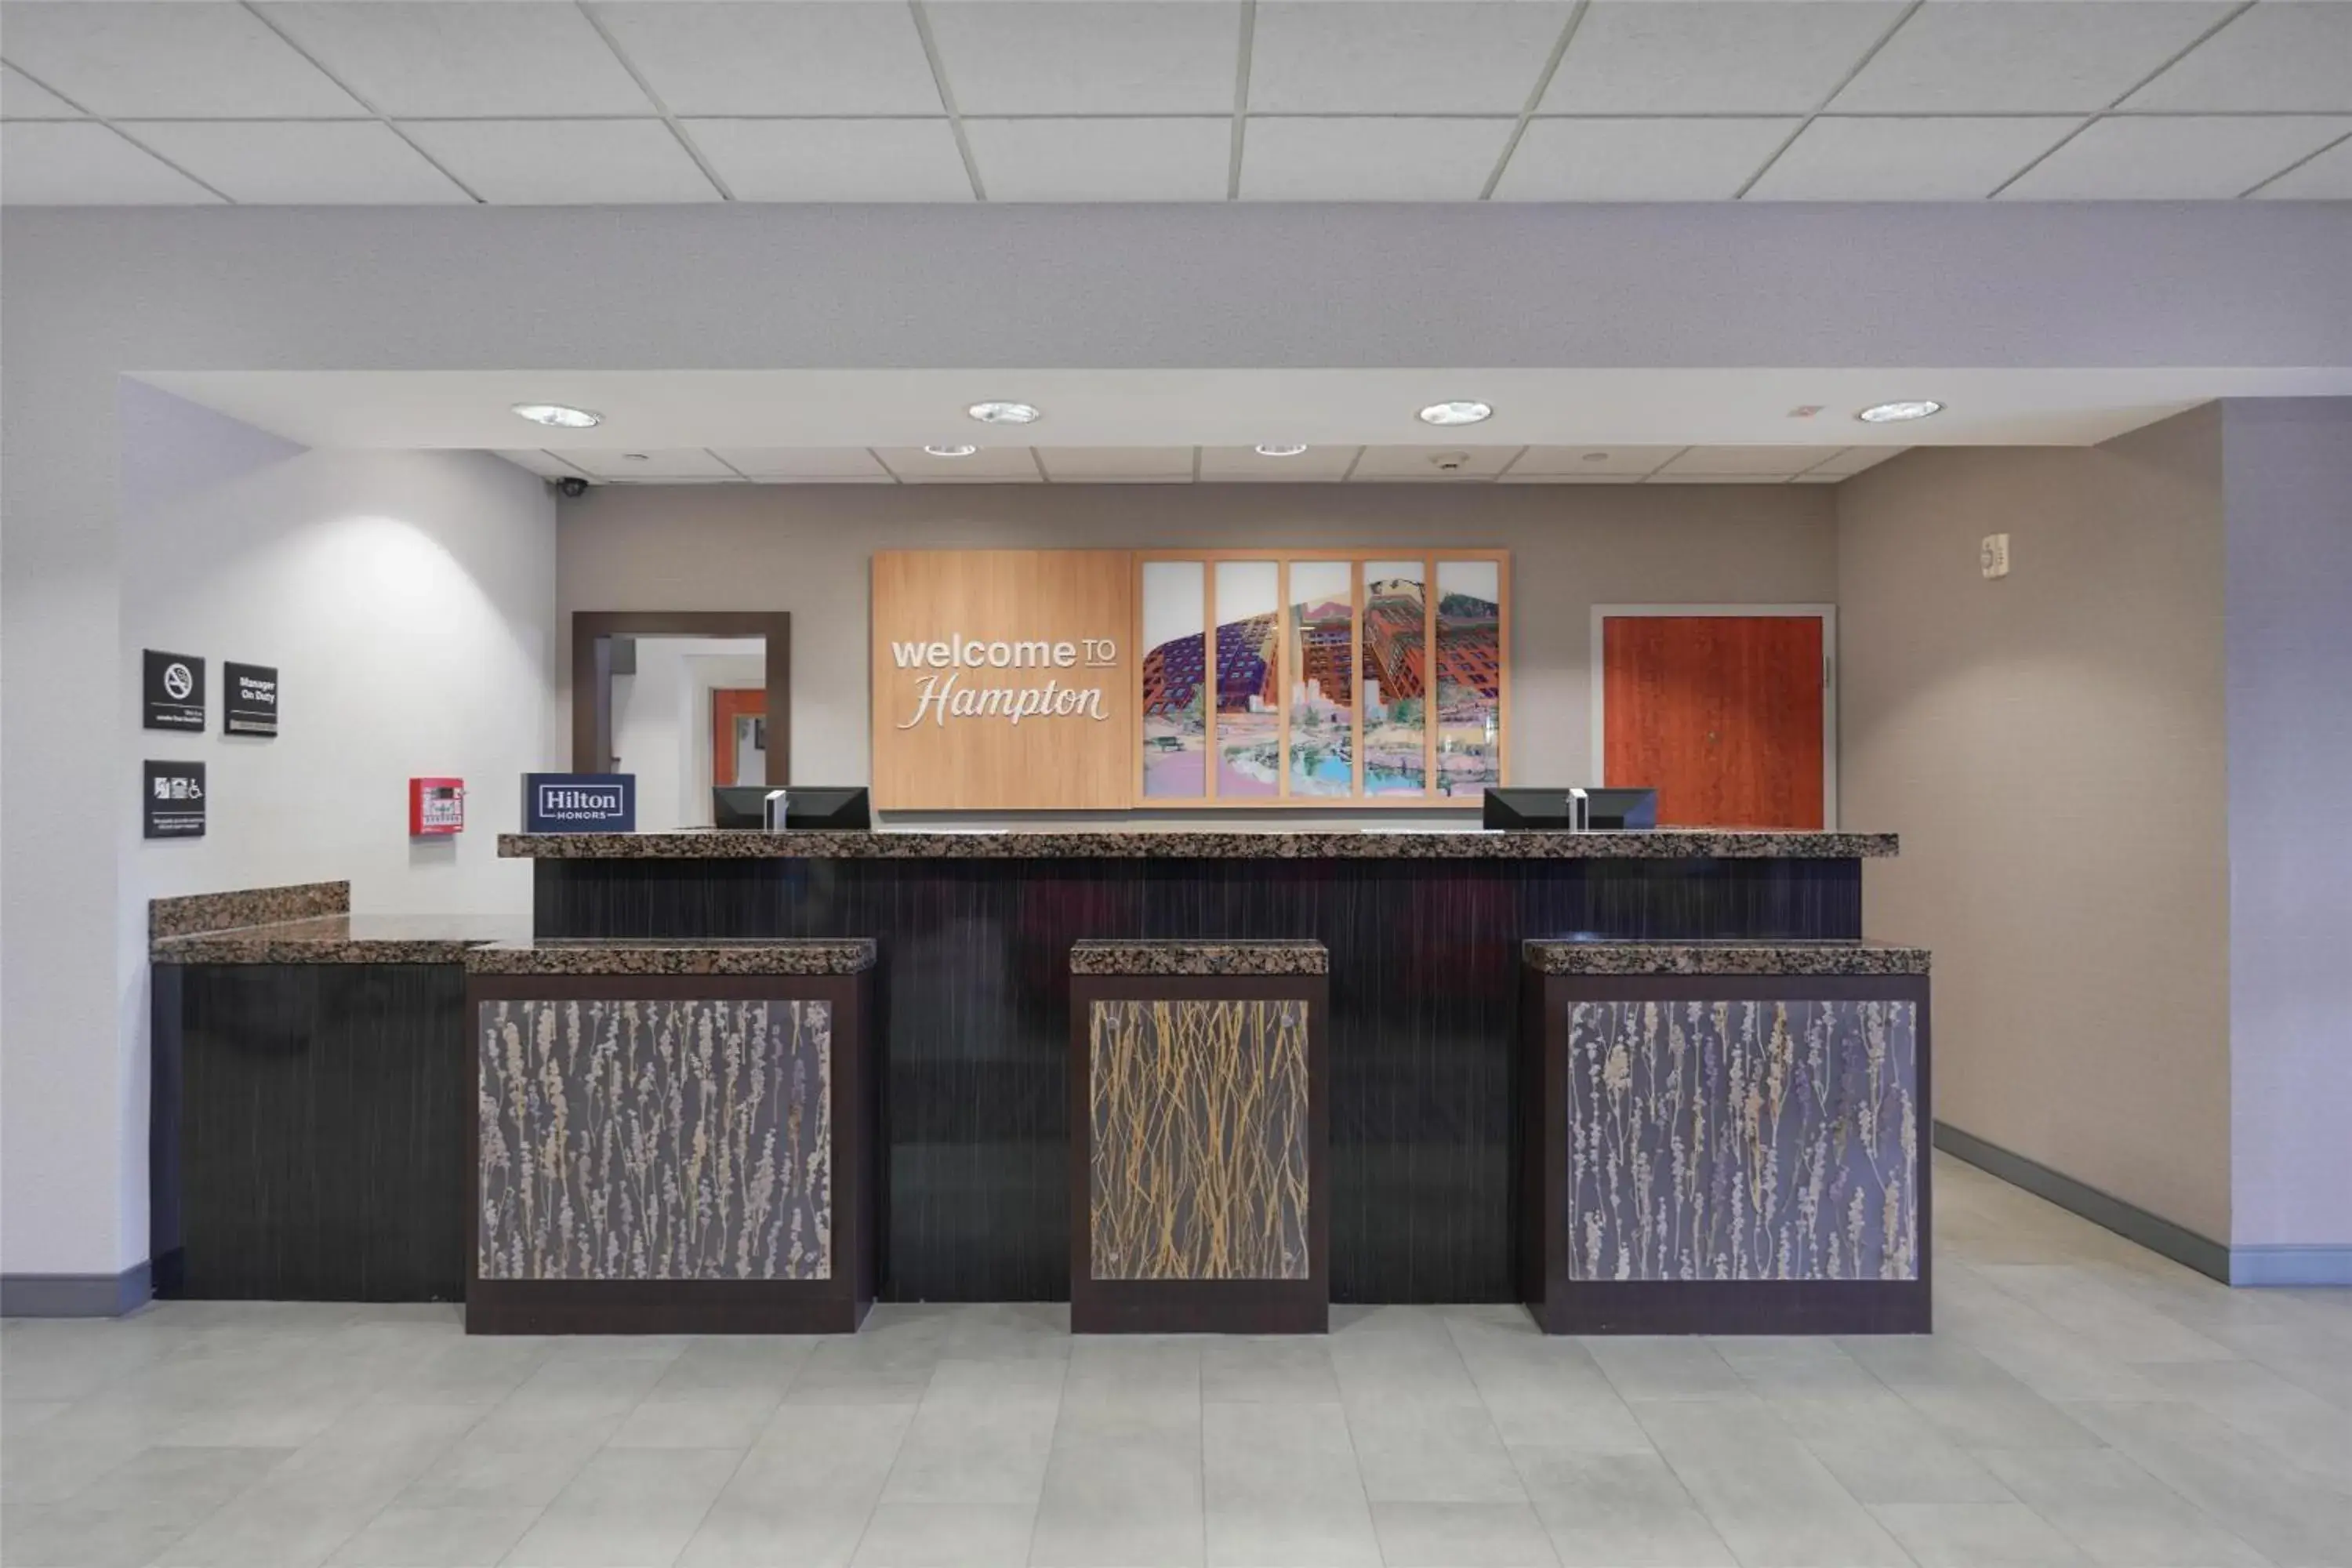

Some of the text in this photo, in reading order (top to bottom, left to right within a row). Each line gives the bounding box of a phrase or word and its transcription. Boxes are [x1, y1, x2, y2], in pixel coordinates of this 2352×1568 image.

[892, 633, 1116, 667] welcome TO
[240, 677, 274, 691] Manager
[241, 689, 274, 705] On Duty
[897, 673, 1109, 728] Hampton
[547, 791, 615, 809] Hilton
[557, 811, 606, 820] HONORS
